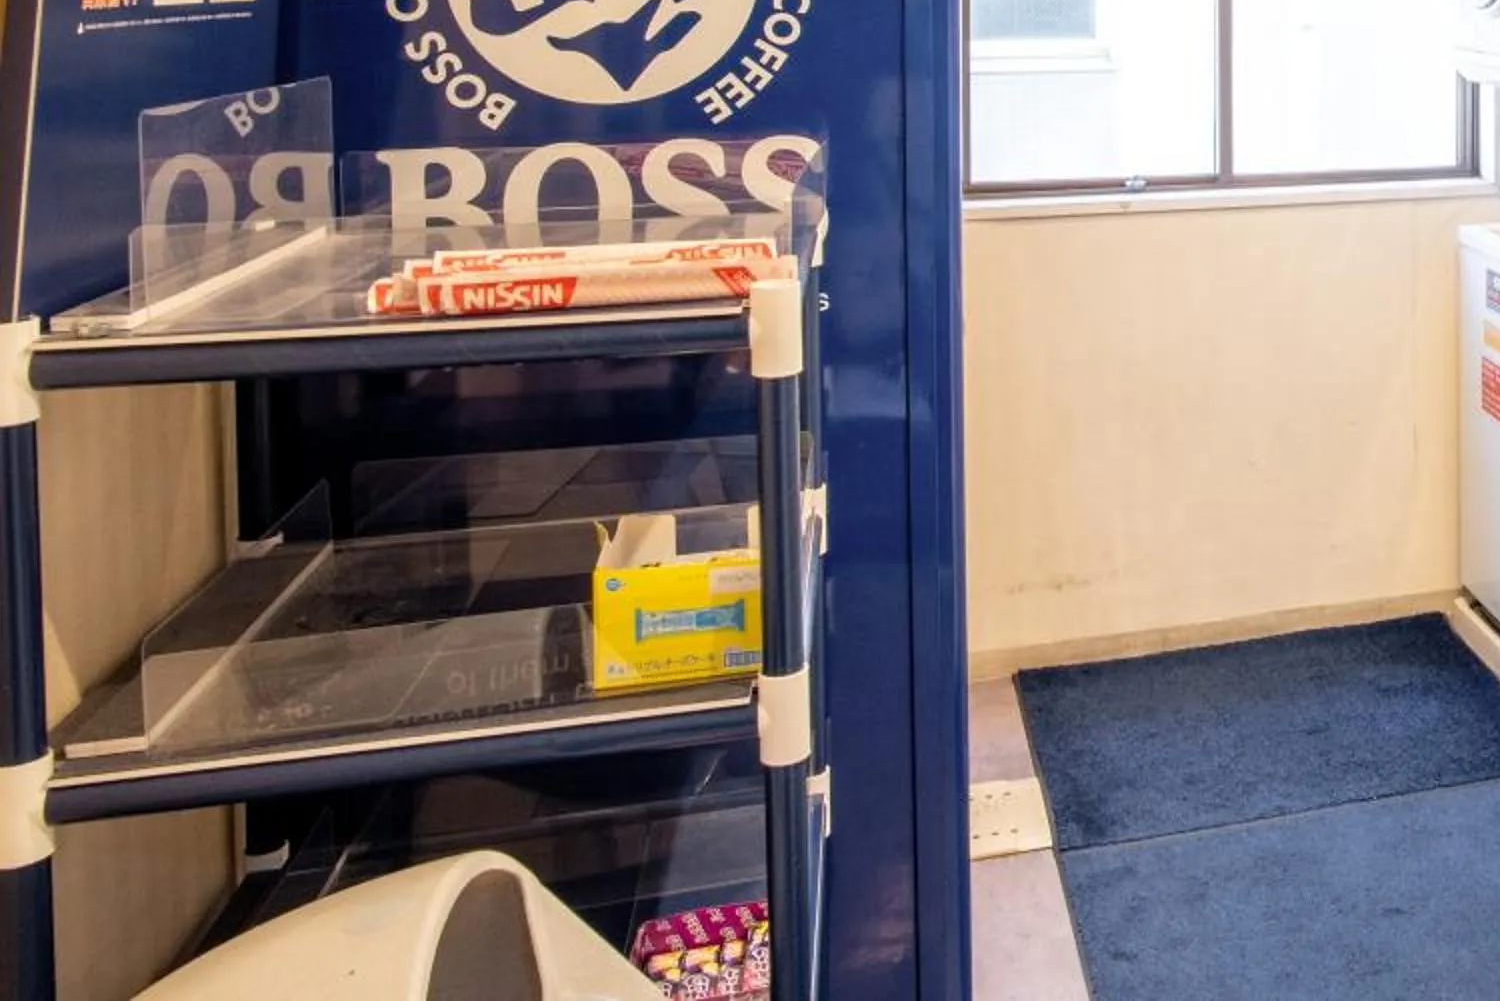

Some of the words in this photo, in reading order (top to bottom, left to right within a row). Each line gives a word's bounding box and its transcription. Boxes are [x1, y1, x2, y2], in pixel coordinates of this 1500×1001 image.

[404, 30, 518, 131] BOSS
[375, 135, 829, 268] BOSS
[462, 278, 565, 311] NISSIN
